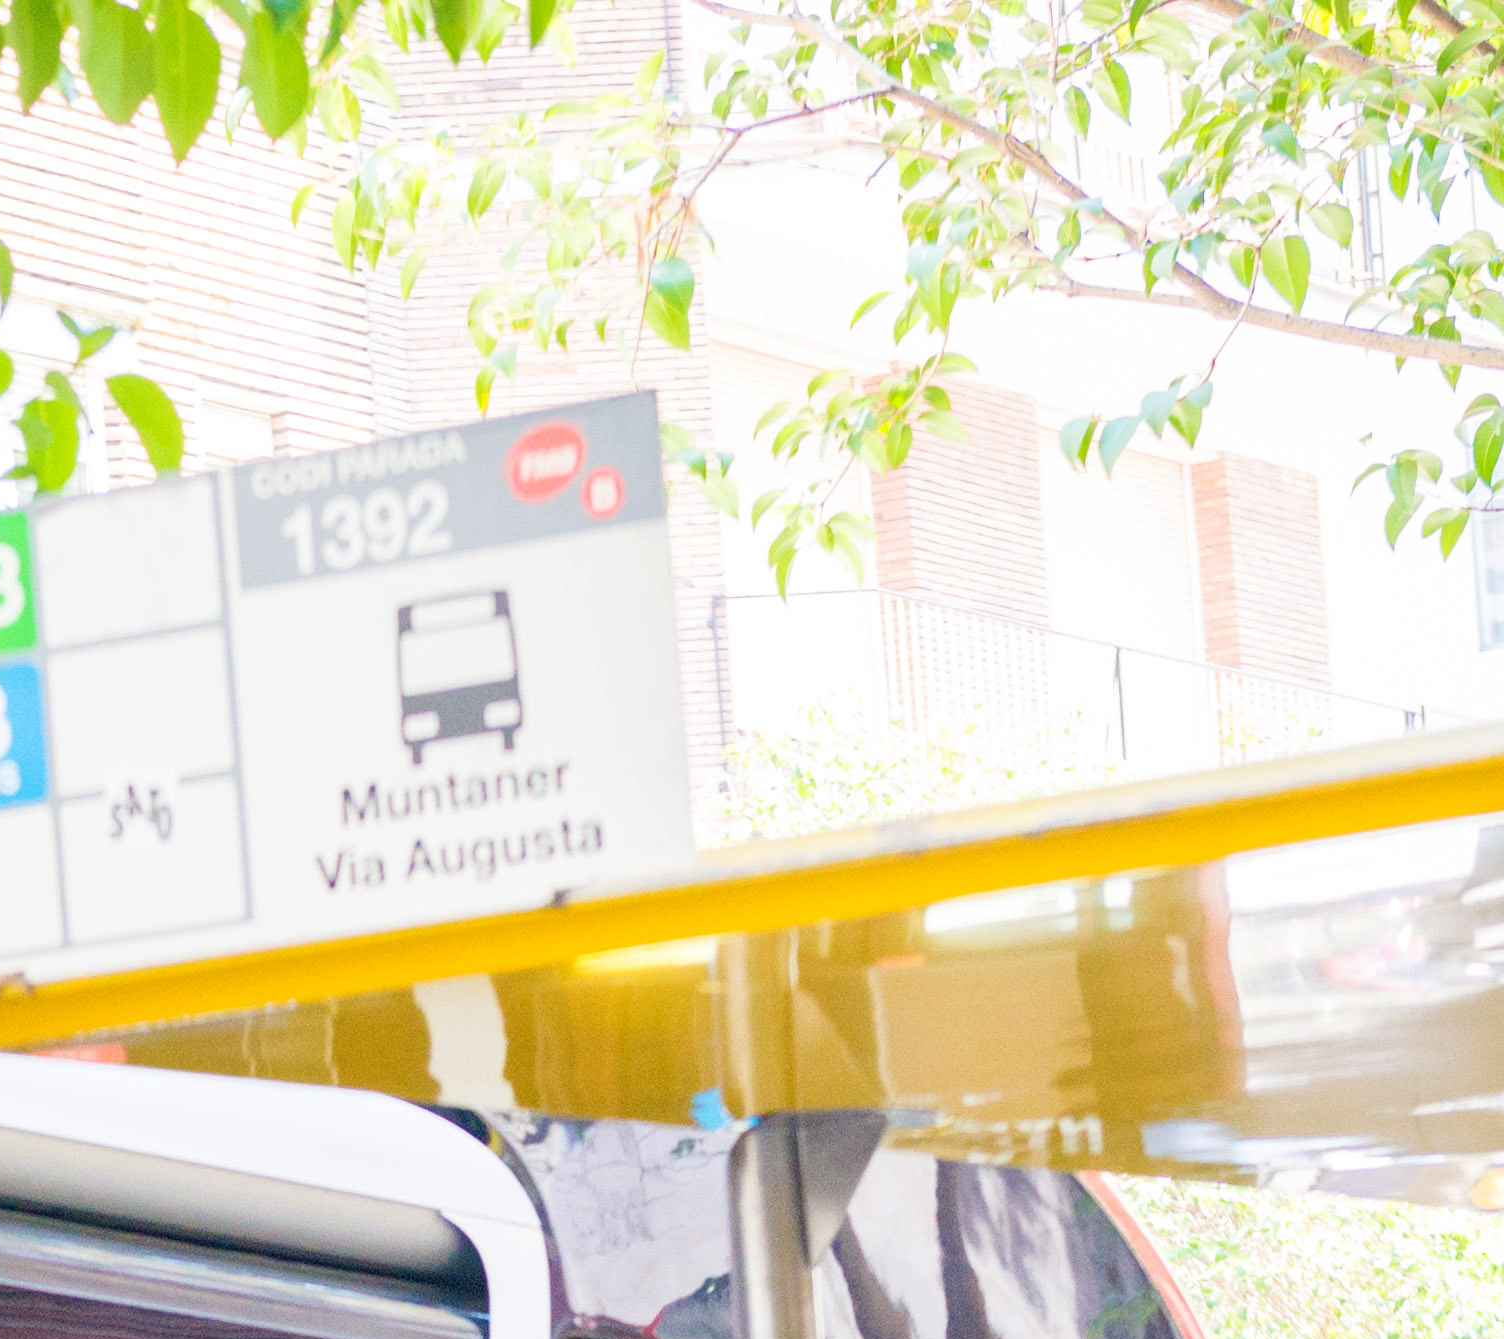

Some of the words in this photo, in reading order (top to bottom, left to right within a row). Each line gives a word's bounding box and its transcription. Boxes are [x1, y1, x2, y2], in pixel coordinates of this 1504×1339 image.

[252, 456, 331, 499] CODI
[338, 431, 467, 484] PARADA
[280, 483, 454, 578] 1392
[340, 760, 572, 828] Muntaner
[317, 848, 387, 893] Via
[404, 816, 608, 884] Augusta
